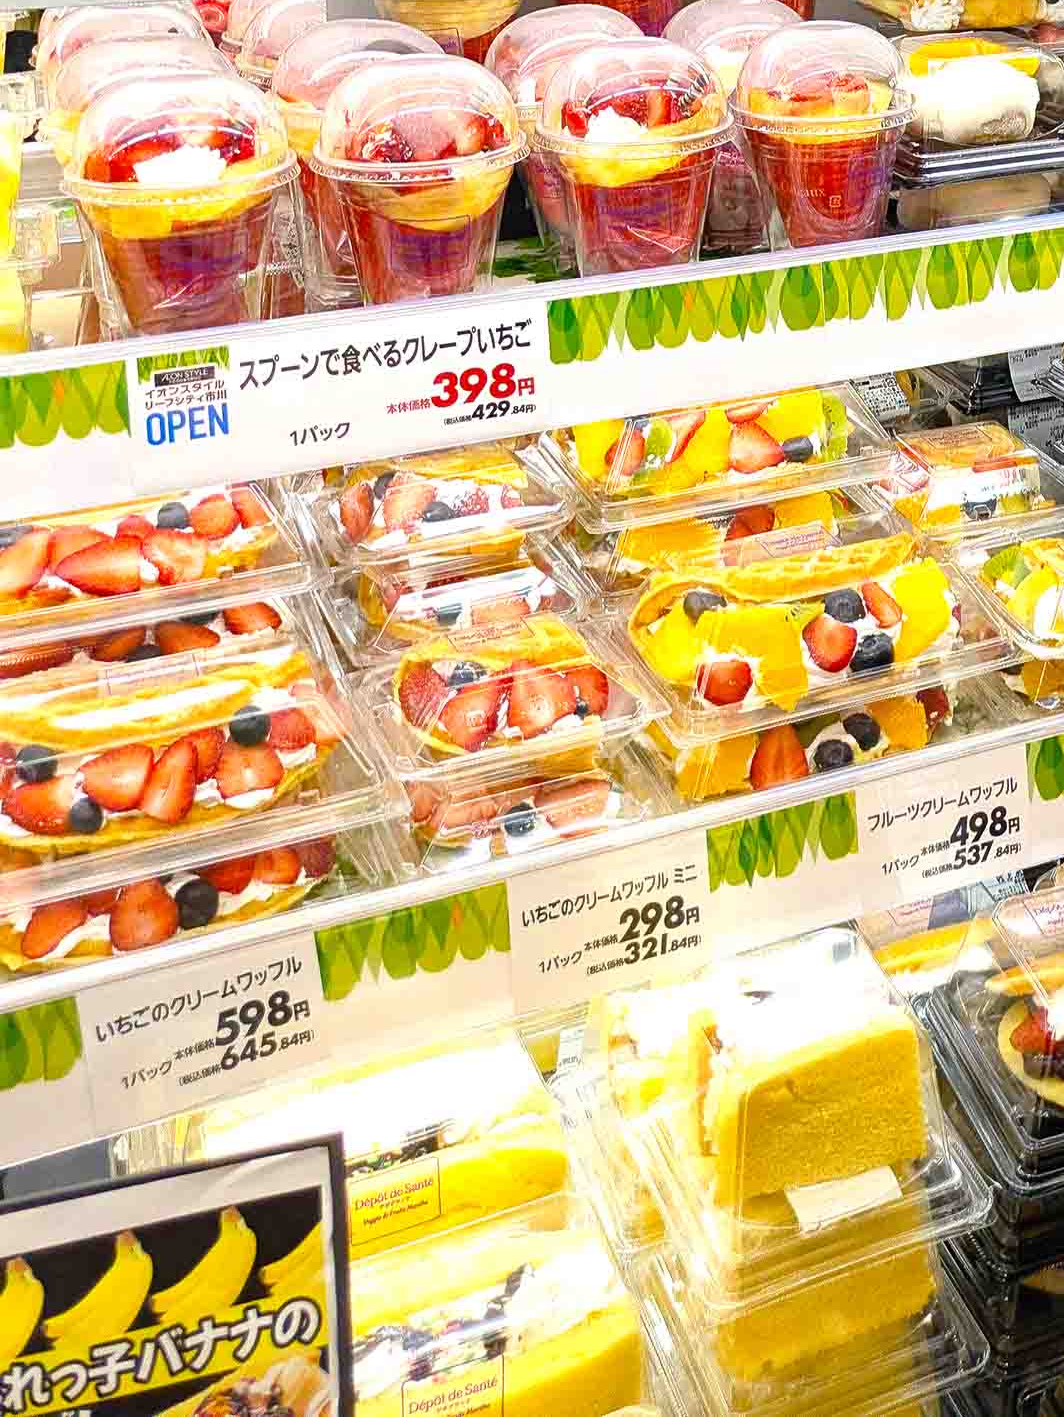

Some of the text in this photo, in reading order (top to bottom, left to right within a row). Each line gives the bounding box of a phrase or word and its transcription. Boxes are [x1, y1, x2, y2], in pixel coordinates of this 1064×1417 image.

[239, 318, 533, 391] スプーンで食べるクレープいちご
[145, 379, 225, 399] イオンスタイル
[145, 389, 227, 410] リーフシティ市川
[146, 402, 230, 446] OPEN
[289, 421, 351, 447] 1パック
[867, 777, 1018, 831] フルーツクリームワッフル
[881, 854, 920, 876] 1パック
[521, 864, 698, 927] いちごのクリームワッフル ミニ
[538, 950, 583, 974] 1パック
[95, 955, 303, 1043] いちごのクリームワッフル
[120, 1060, 173, 1090] 1パック
[446, 1387, 464, 1401] de
[464, 1375, 499, 1395] Santé
